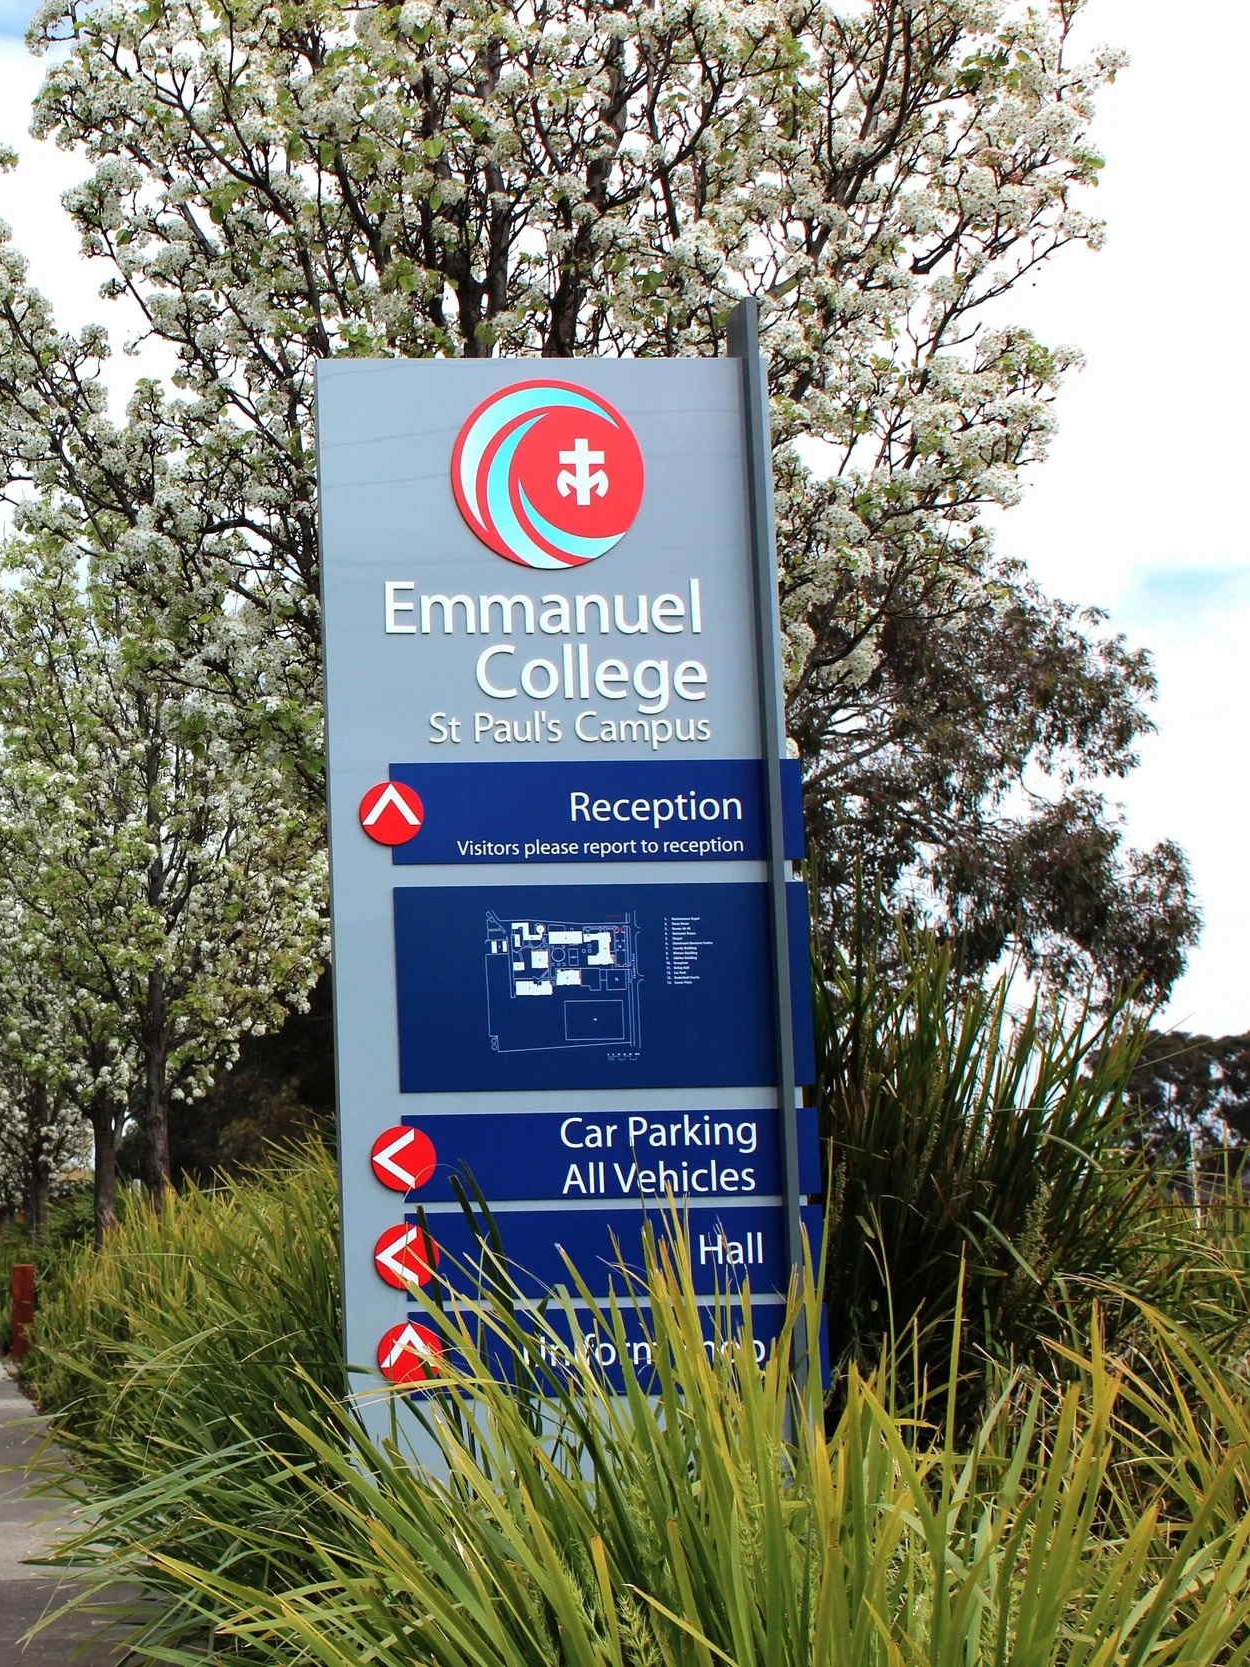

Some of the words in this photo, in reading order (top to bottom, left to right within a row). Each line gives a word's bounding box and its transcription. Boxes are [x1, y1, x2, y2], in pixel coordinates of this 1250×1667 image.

[384, 578, 702, 635] Emmanuel
[475, 643, 709, 715] College
[428, 712, 462, 744] St
[474, 710, 563, 744] Paul's
[575, 711, 712, 750] Campus
[570, 790, 743, 828] Reception
[457, 840, 520, 857] Visitors
[524, 839, 579, 859] please
[583, 840, 637, 858] report
[640, 840, 659, 855] to
[663, 838, 745, 857] reception
[560, 1116, 618, 1149] Car
[628, 1114, 758, 1154] Parking
[562, 1161, 606, 1195] All
[613, 1159, 757, 1194] Vehicles
[699, 1231, 764, 1265] Hall
[523, 1333, 664, 1367] Unfom
